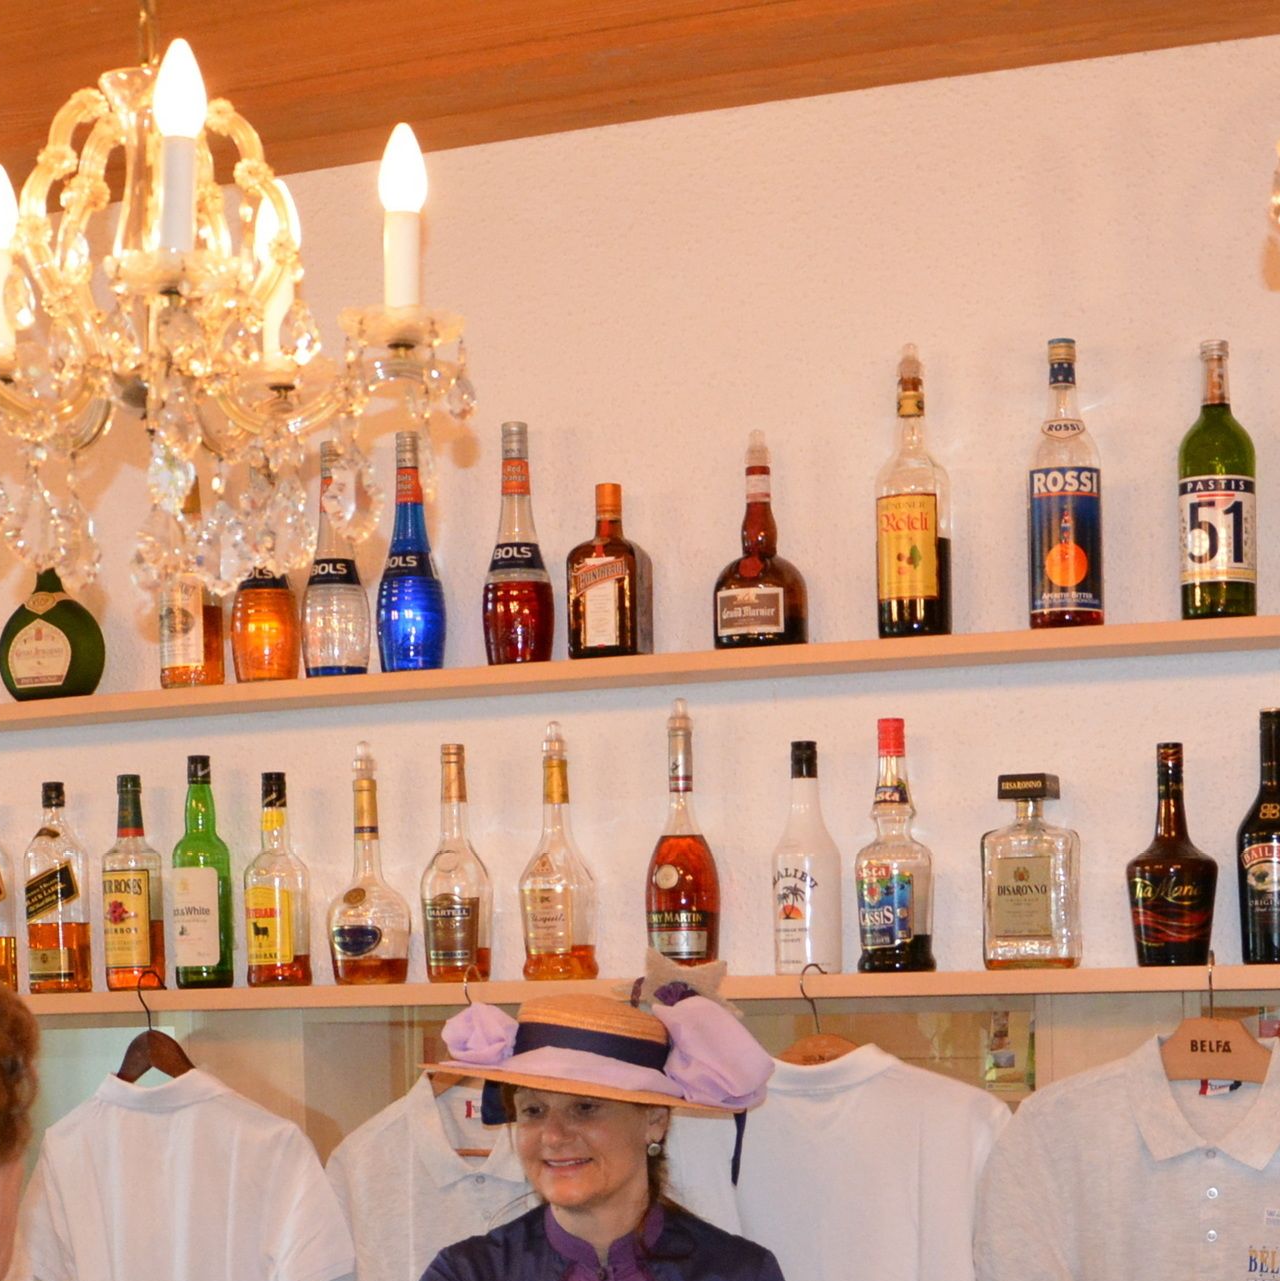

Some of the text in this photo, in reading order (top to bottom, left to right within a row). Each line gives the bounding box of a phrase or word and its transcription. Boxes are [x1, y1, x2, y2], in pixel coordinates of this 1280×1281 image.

[1047, 423, 1081, 432] ROSSI
[1033, 470, 1098, 494] ROSSI
[1186, 480, 1246, 493] PASTIS
[1187, 500, 1245, 564] 51
[492, 546, 532, 560] BOLS
[1000, 780, 1043, 790] DISARONNO
[997, 885, 1048, 897] DISARONNO
[1190, 1039, 1233, 1053] BELFA
